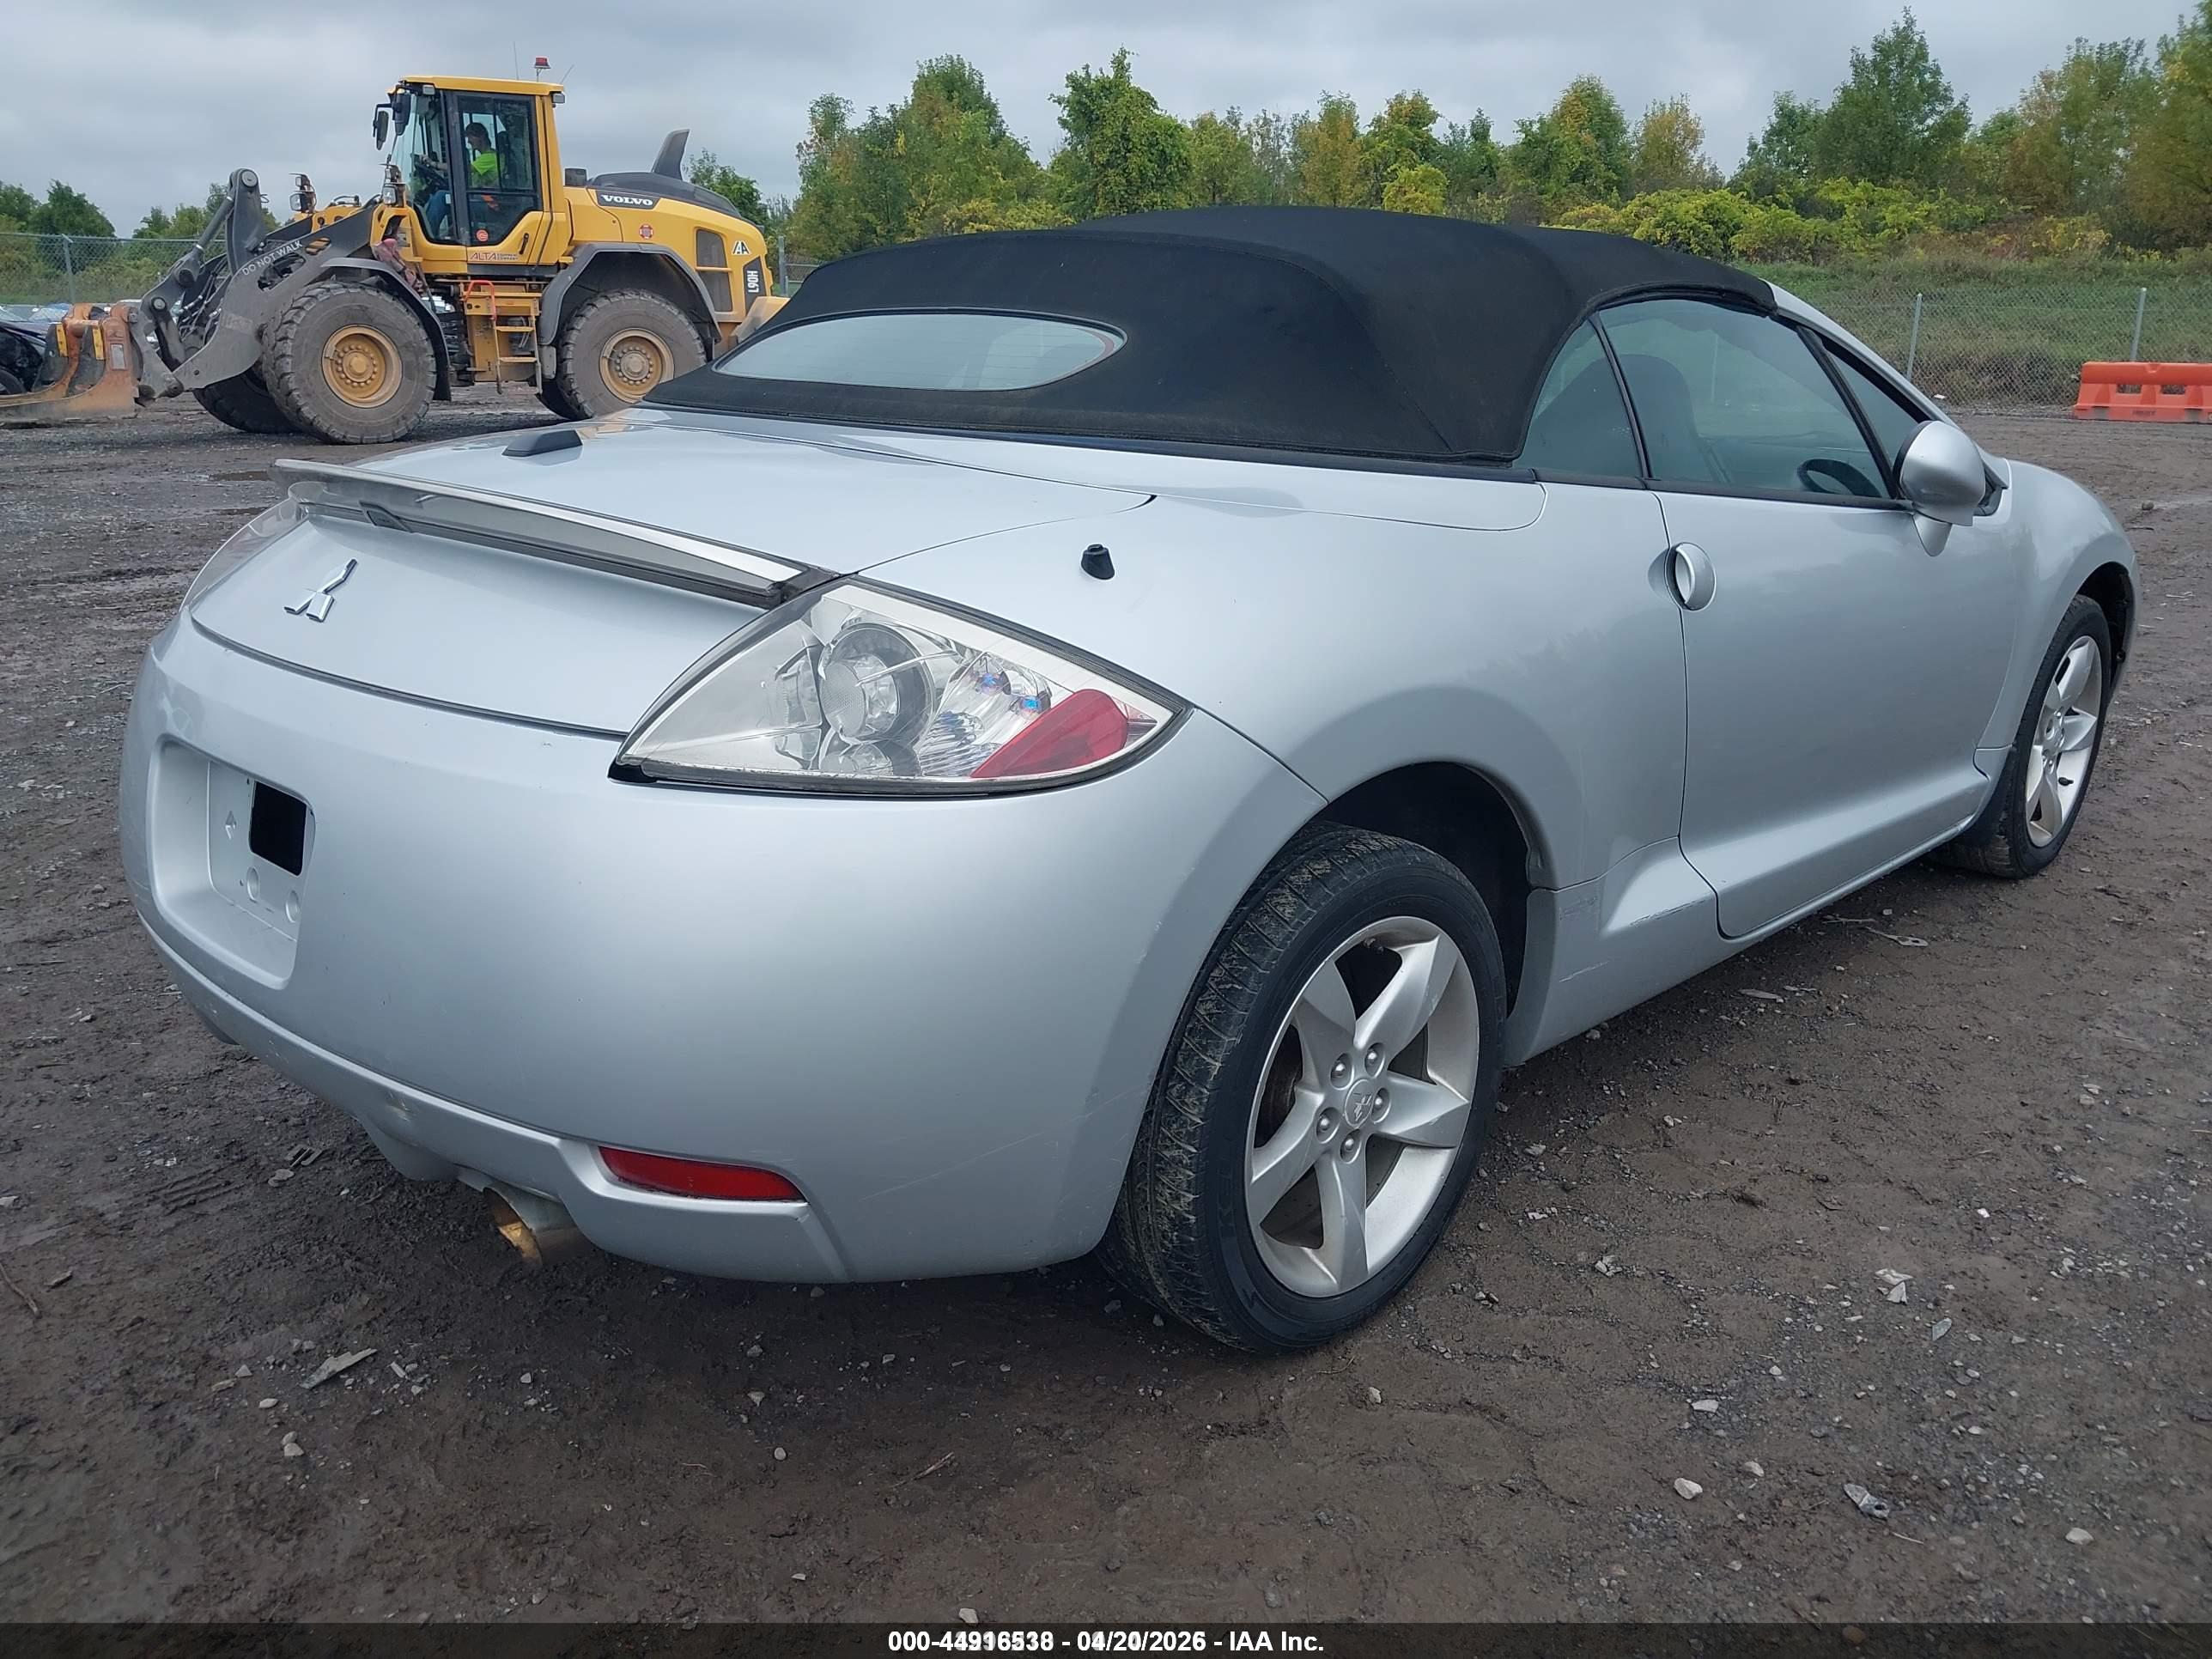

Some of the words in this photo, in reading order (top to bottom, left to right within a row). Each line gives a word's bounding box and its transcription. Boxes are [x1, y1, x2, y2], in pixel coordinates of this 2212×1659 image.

[601, 194, 653, 205] VOLVO
[242, 264, 256, 276] DO
[257, 252, 276, 268] NOT
[276, 240, 303, 256] WALK
[747, 270, 759, 293] L90H
